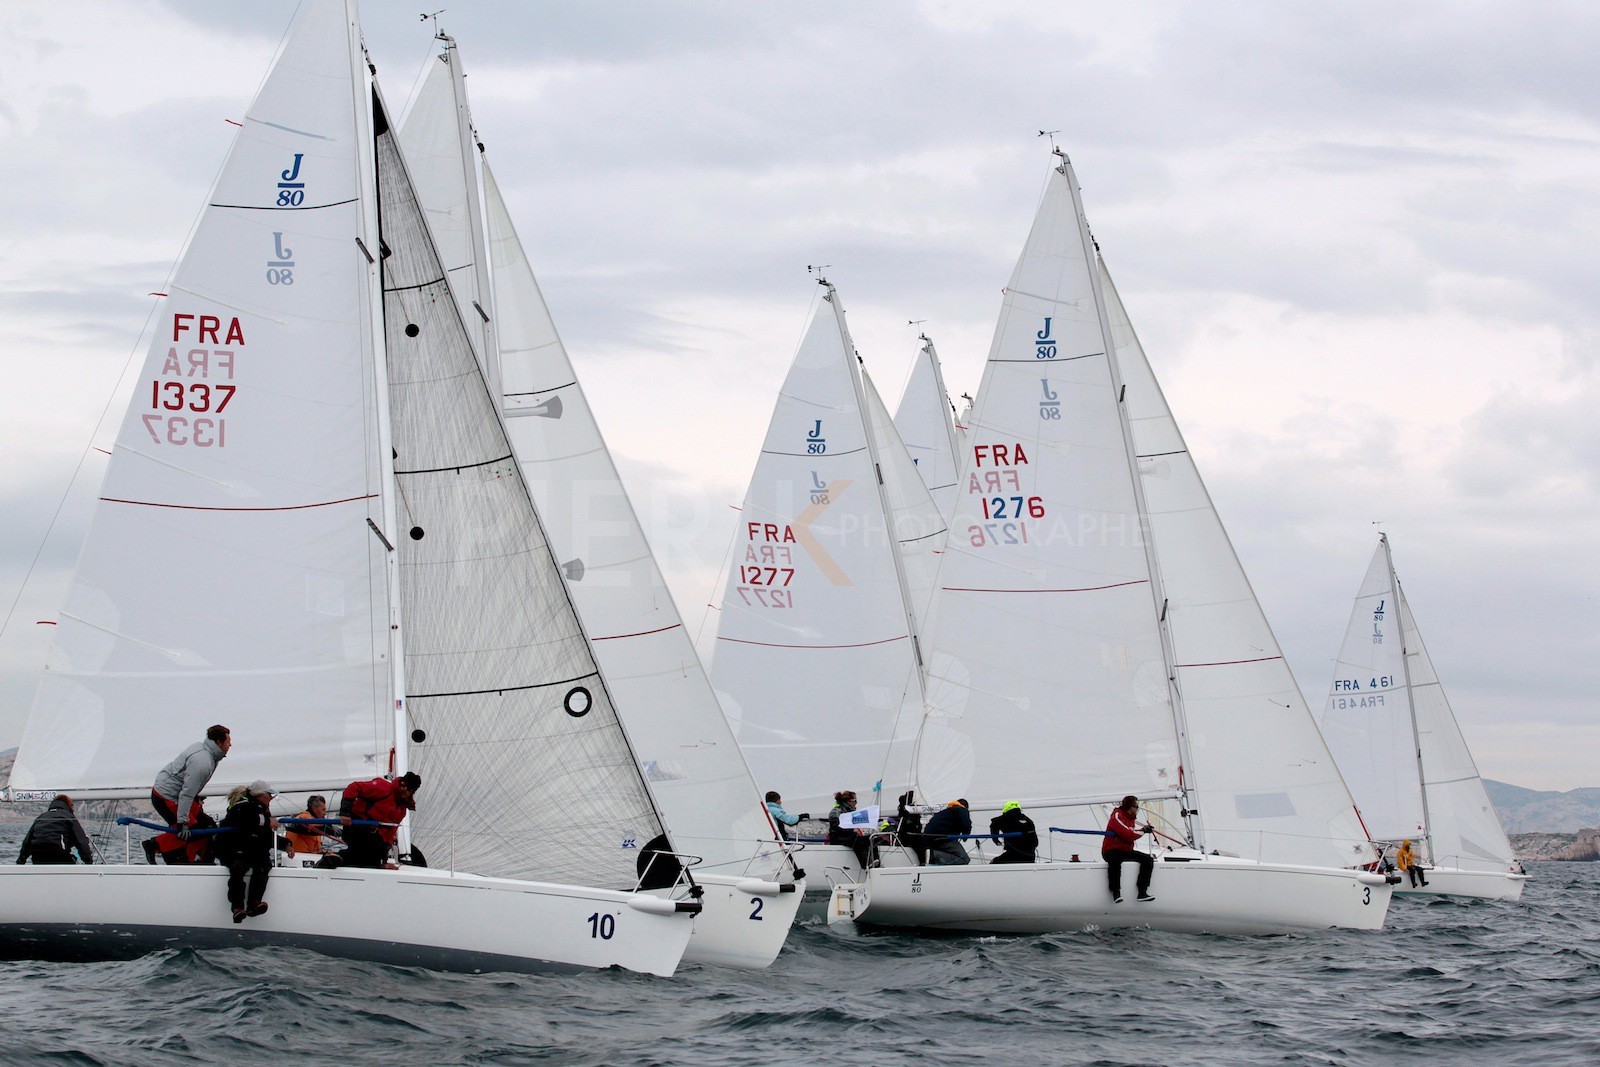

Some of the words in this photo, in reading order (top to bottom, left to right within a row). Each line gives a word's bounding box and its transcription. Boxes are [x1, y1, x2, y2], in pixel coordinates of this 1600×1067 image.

[281, 154, 304, 181] J
[276, 190, 304, 207] 80
[173, 313, 245, 345] FRA
[1037, 317, 1052, 339] J
[1036, 346, 1056, 359] 80
[152, 380, 236, 413] 1337
[808, 420, 822, 438] J
[806, 443, 826, 455] 80
[974, 443, 1028, 467] FRA
[982, 496, 1045, 520] 1276
[748, 522, 796, 543] FRA
[740, 565, 795, 587] 1277
[1376, 600, 1384, 611] J
[1374, 614, 1383, 622] 80
[1335, 679, 1360, 691] FRA
[1370, 675, 1394, 689] 461
[913, 873, 921, 884] J
[911, 886, 922, 894] 80
[1362, 887, 1371, 906] 3
[749, 897, 764, 921] 2
[587, 912, 615, 940] 10
